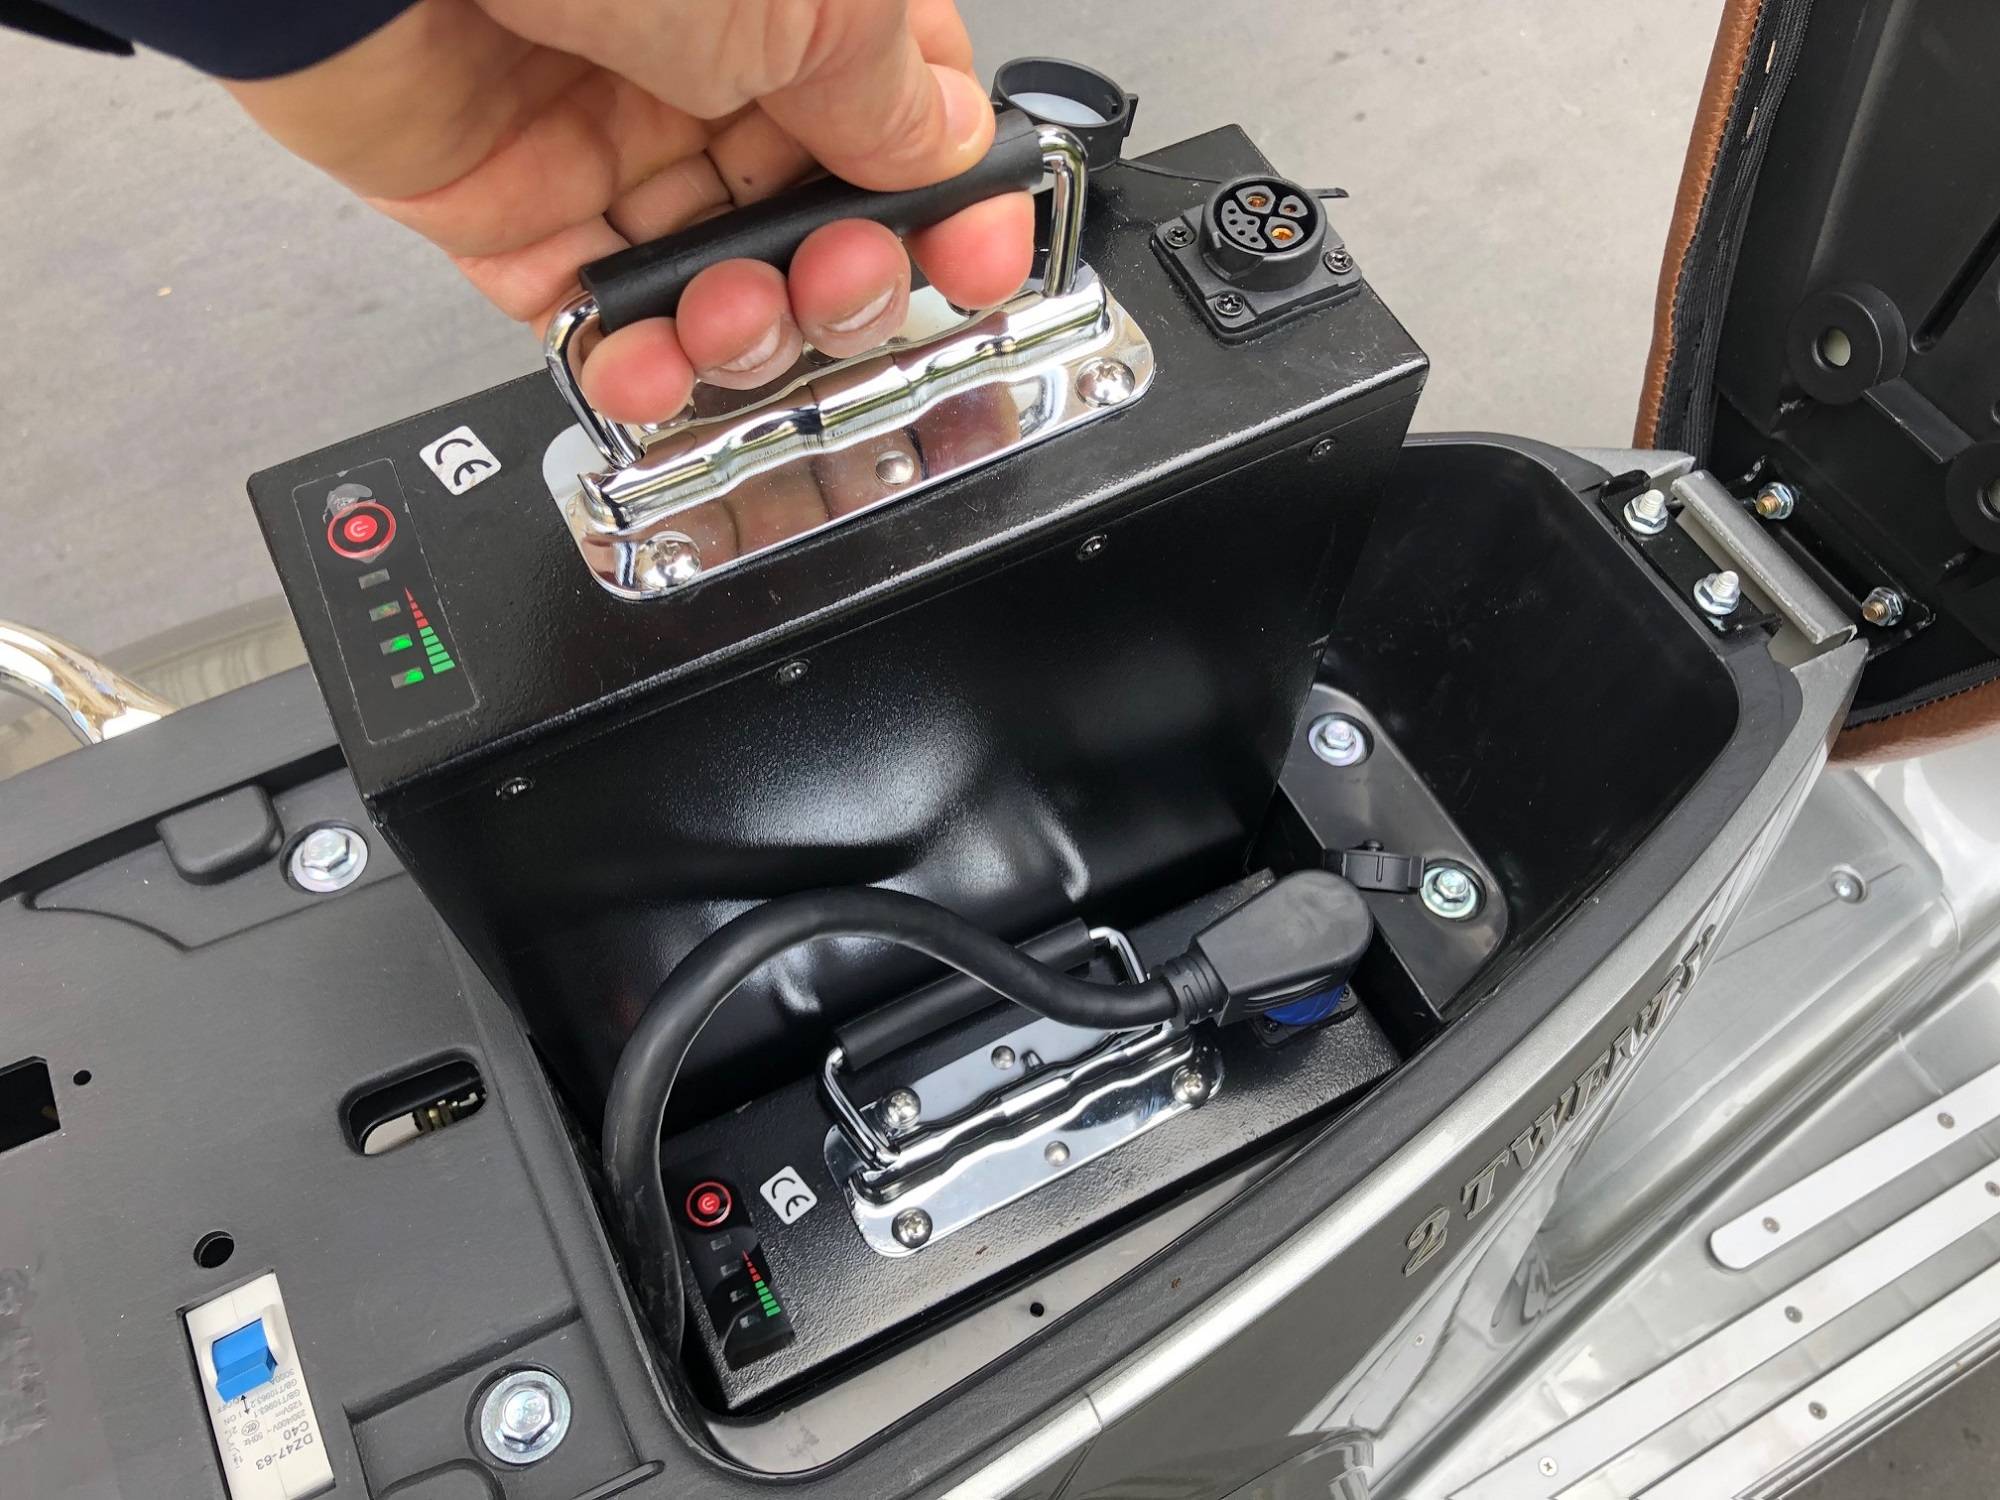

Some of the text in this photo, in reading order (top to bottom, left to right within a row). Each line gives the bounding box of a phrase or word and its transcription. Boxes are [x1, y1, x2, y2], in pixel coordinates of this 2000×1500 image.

[435, 438, 492, 486] CE
[772, 1177, 810, 1217] CE
[1404, 1206, 1449, 1276] 2
[283, 1420, 310, 1440] C40
[255, 1433, 314, 1470] DZ47-63
